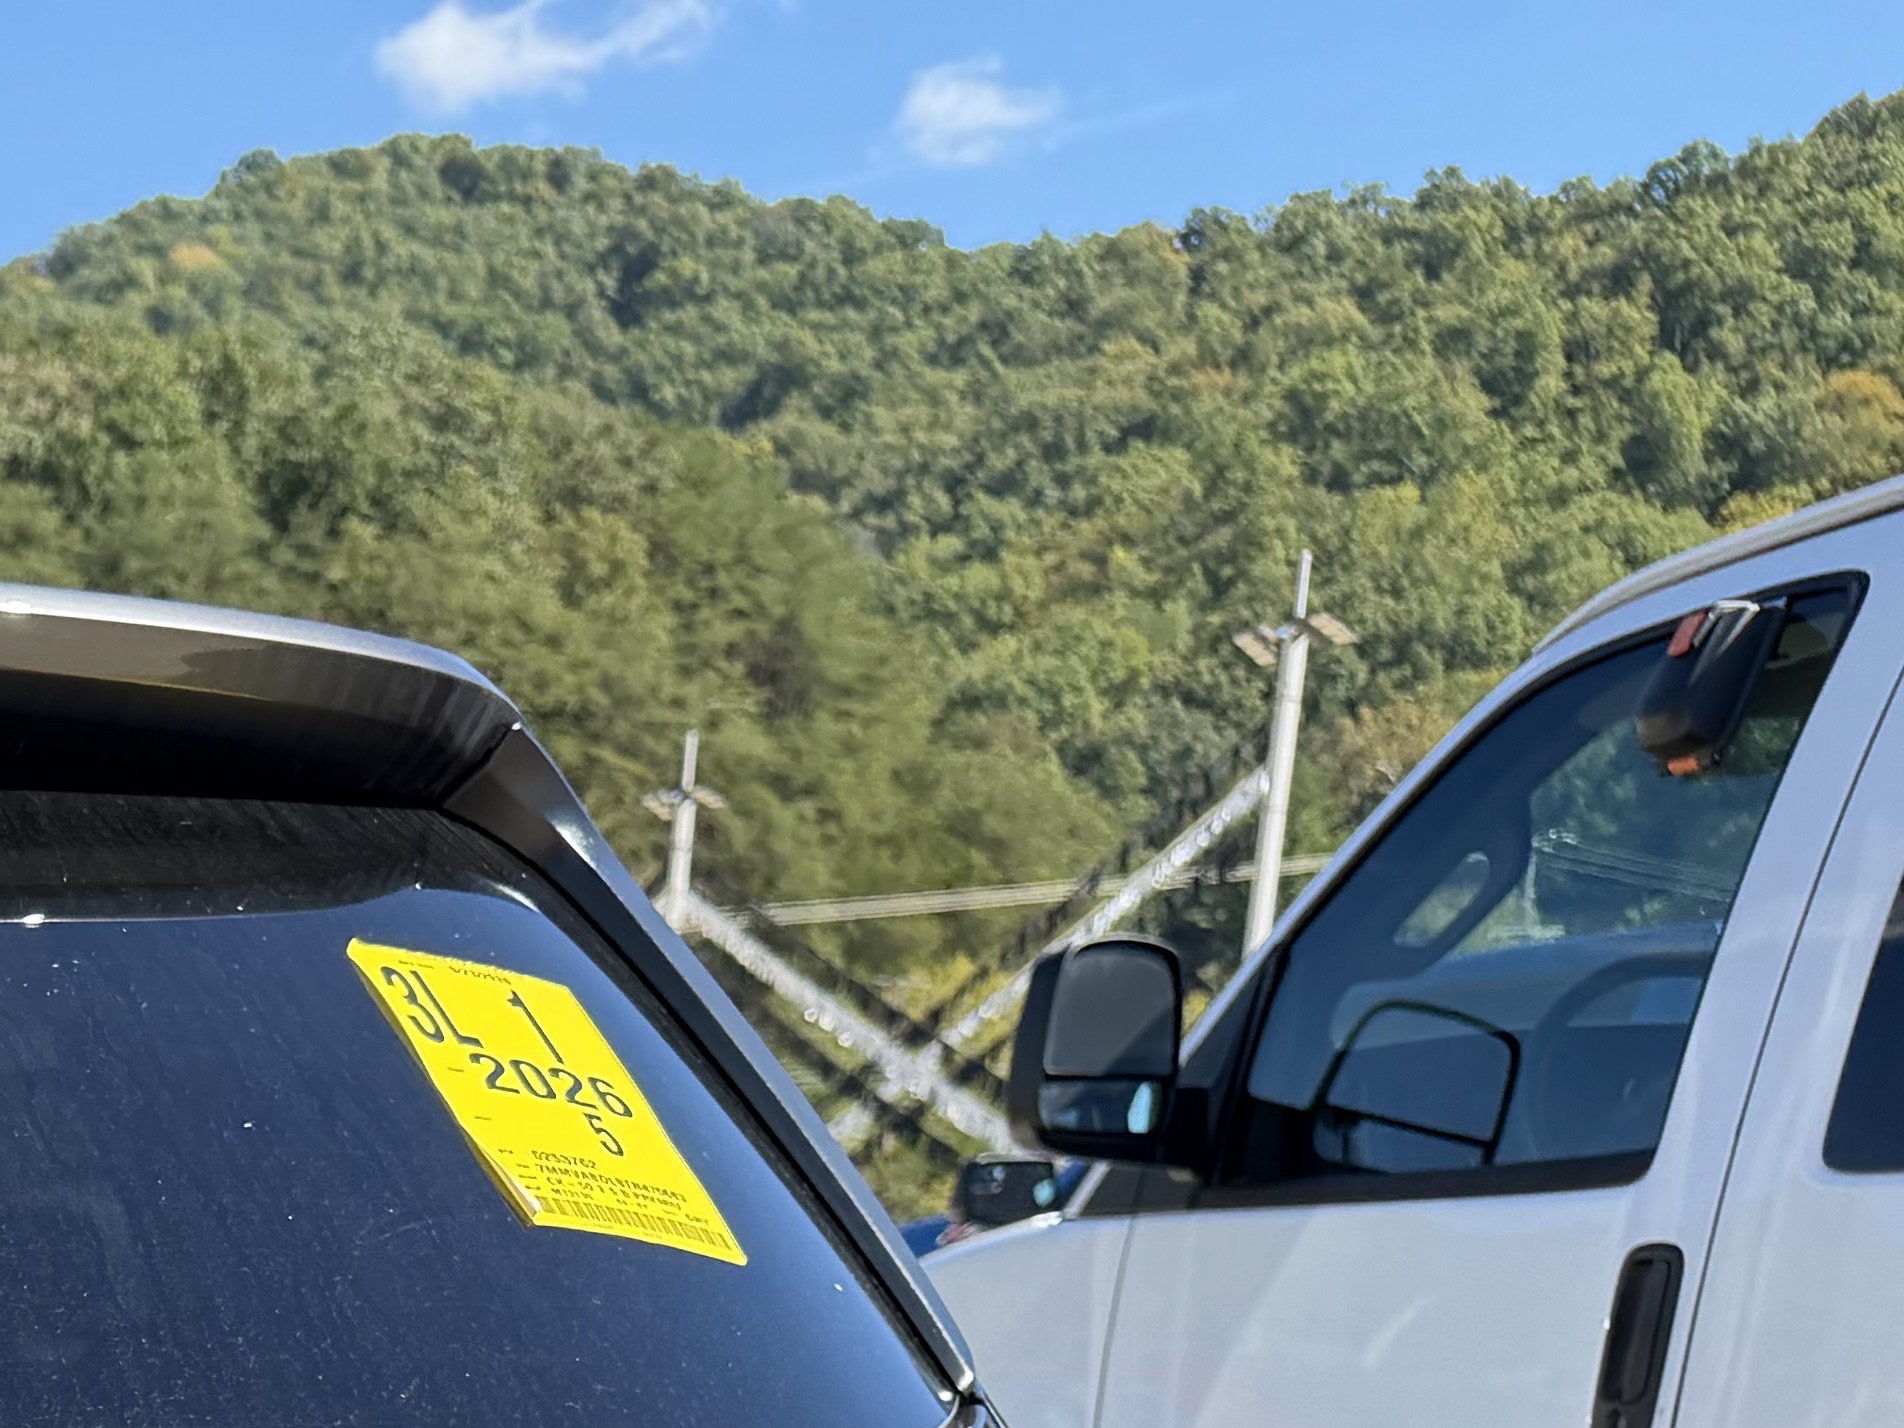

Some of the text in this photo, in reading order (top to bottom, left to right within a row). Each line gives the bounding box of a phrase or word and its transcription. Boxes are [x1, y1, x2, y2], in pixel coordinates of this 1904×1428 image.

[380, 965, 565, 1066] 3L 1
[468, 1052, 634, 1118] 2026
[582, 1111, 625, 1157] 5
